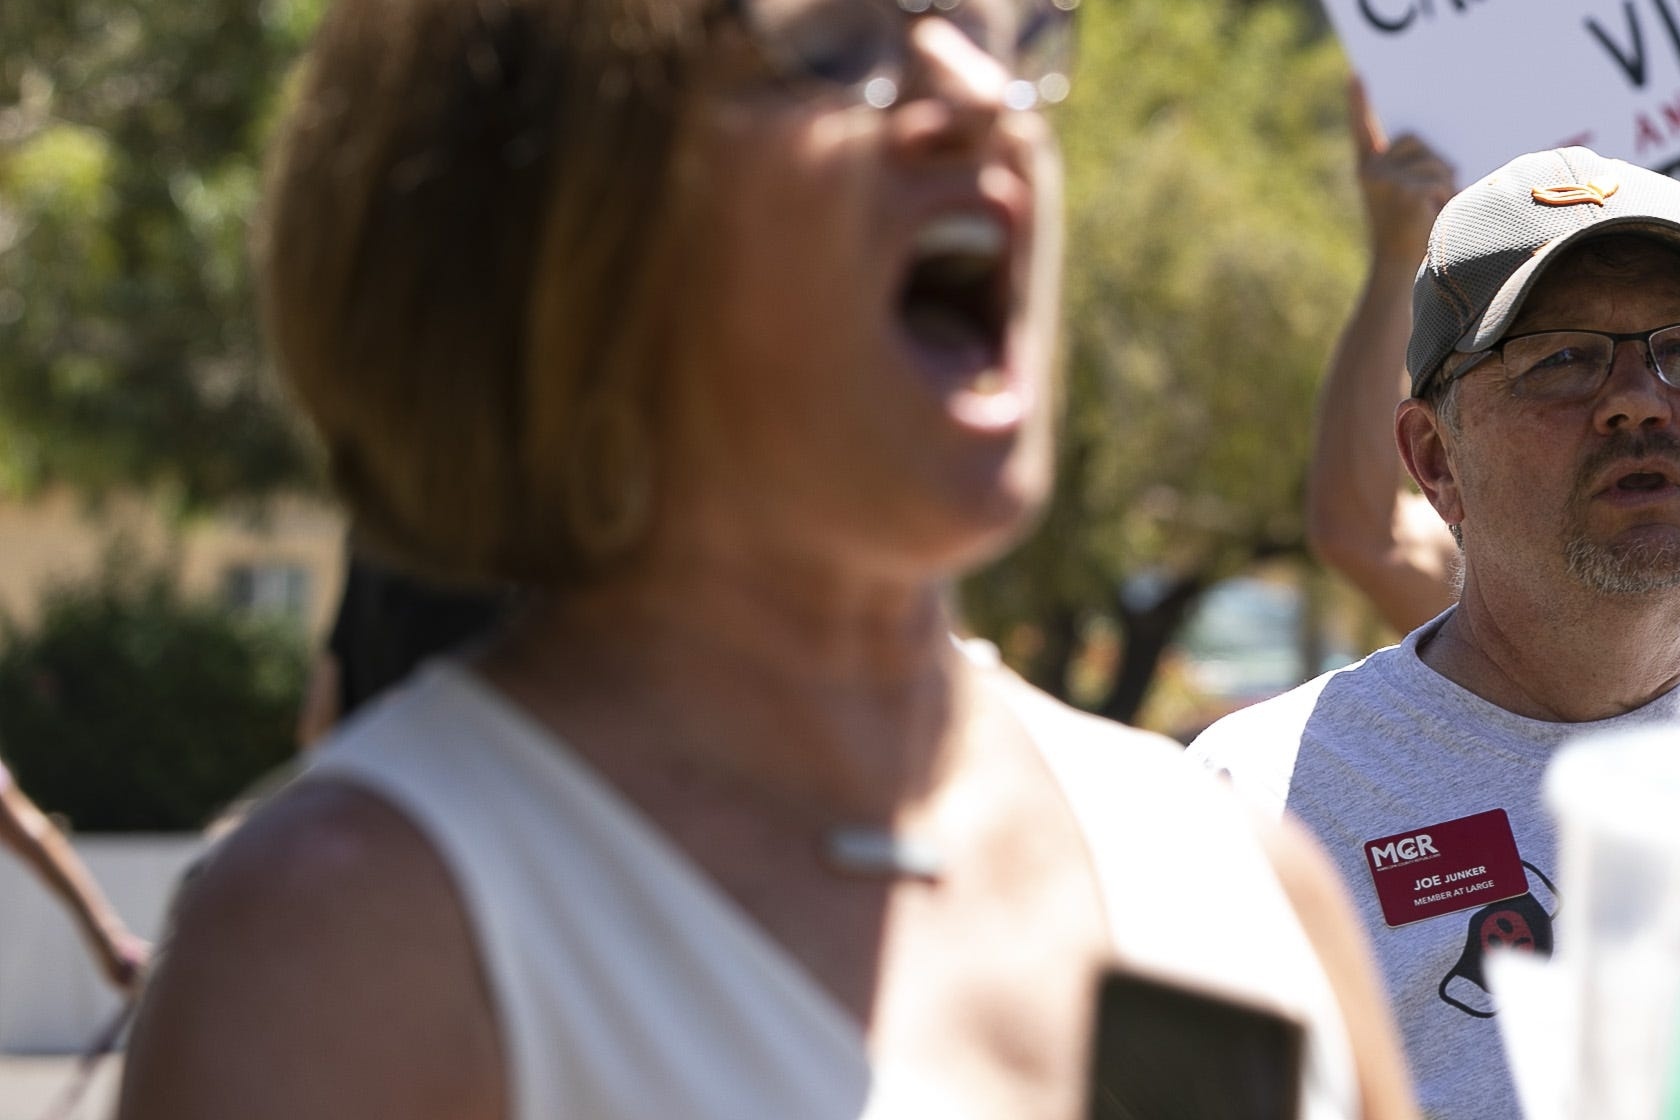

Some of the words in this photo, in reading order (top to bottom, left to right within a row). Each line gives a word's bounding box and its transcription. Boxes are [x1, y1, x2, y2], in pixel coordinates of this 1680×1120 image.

[1413, 874, 1442, 891] JOE
[1444, 865, 1487, 883] JUNKER
[1413, 890, 1453, 907] MEMBER
[1453, 887, 1465, 897] AT
[1465, 879, 1495, 893] LARGE
